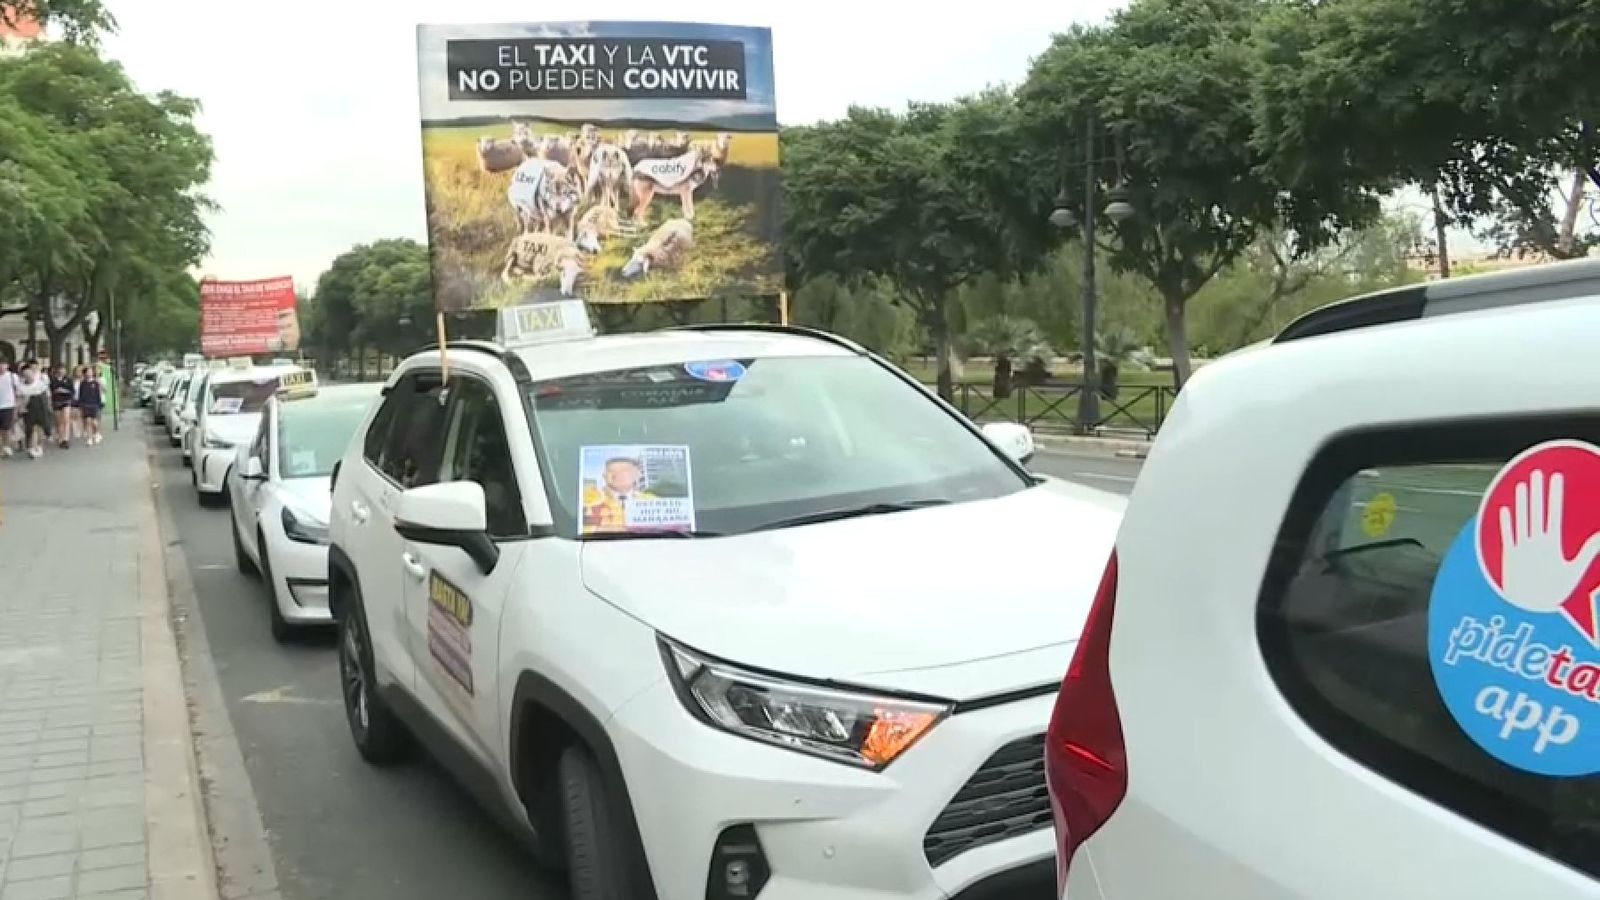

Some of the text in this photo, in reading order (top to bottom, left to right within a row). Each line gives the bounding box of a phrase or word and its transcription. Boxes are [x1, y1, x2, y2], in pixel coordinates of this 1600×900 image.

[498, 44, 708, 67] EL TAXI Y LA VTC
[458, 68, 739, 91] NO PUEDEN CONVIVIR
[651, 162, 687, 175] cabify
[523, 241, 548, 255] TAXI
[522, 307, 561, 330] TAXI
[1475, 685, 1579, 754] app
